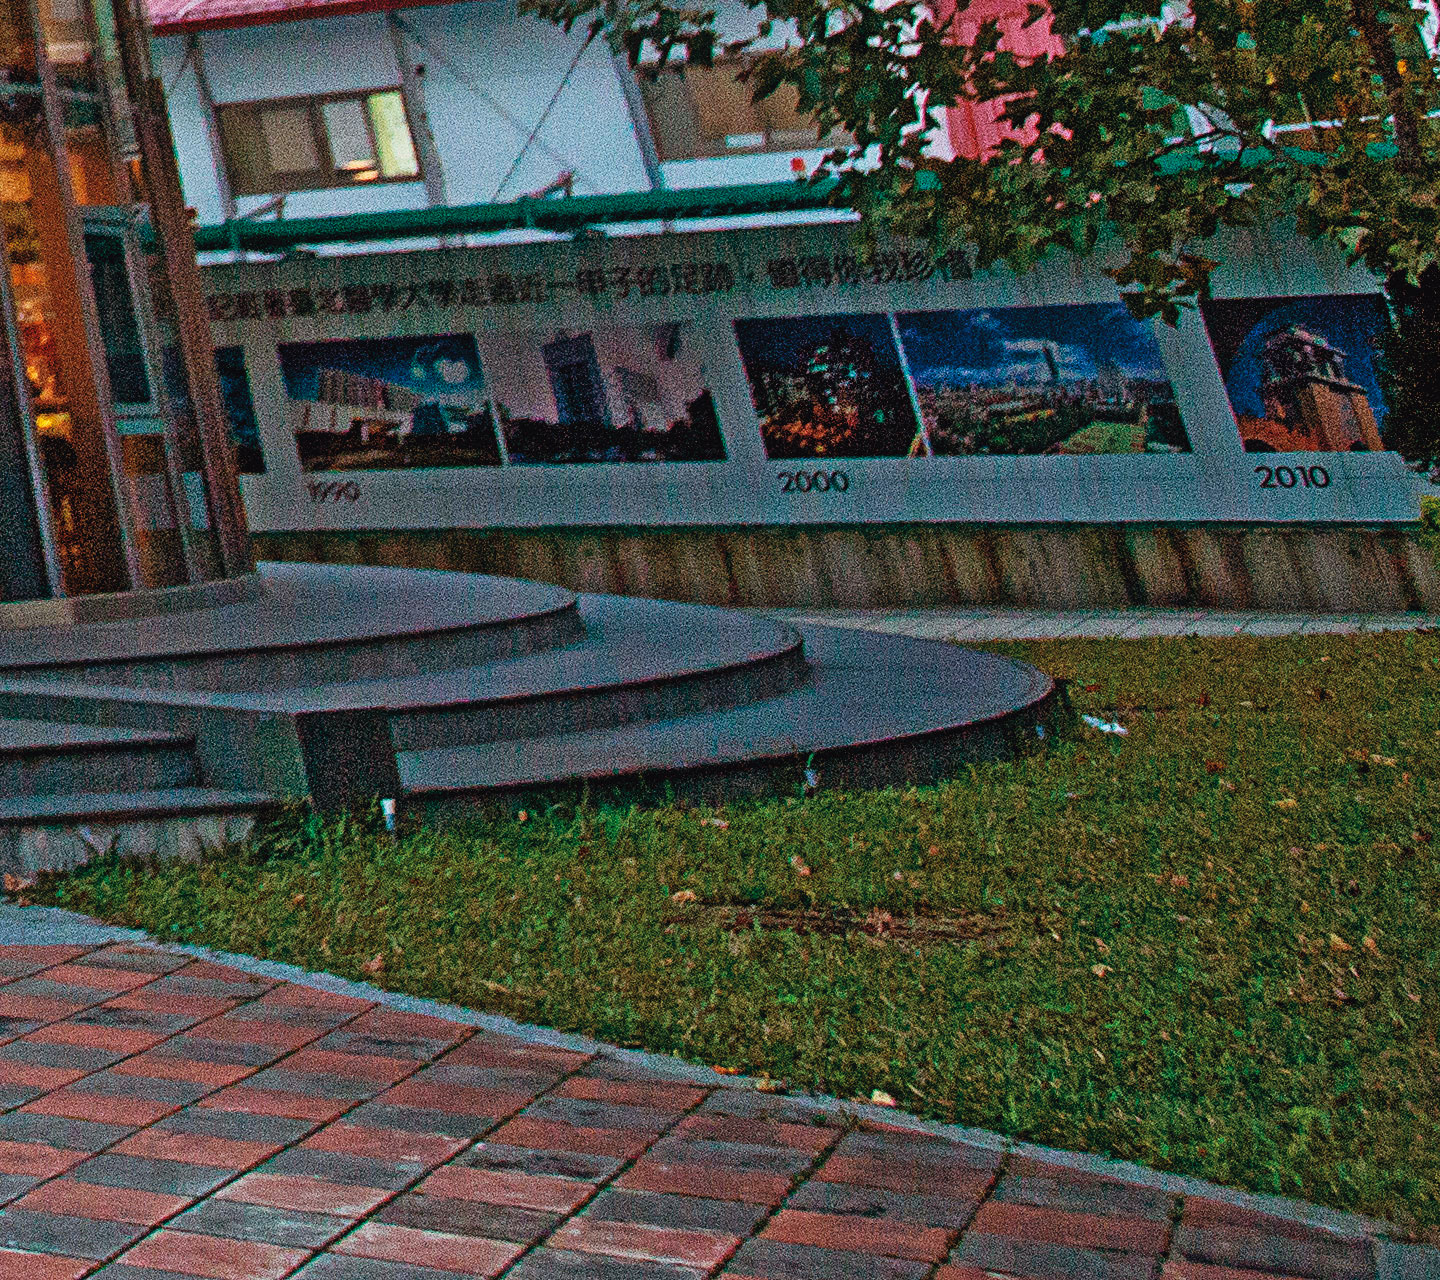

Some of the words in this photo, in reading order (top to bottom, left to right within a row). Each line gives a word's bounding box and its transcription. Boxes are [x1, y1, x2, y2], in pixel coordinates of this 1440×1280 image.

[778, 470, 849, 493] 2000
[1254, 465, 1330, 489] 2010
[307, 480, 361, 502] 1990
